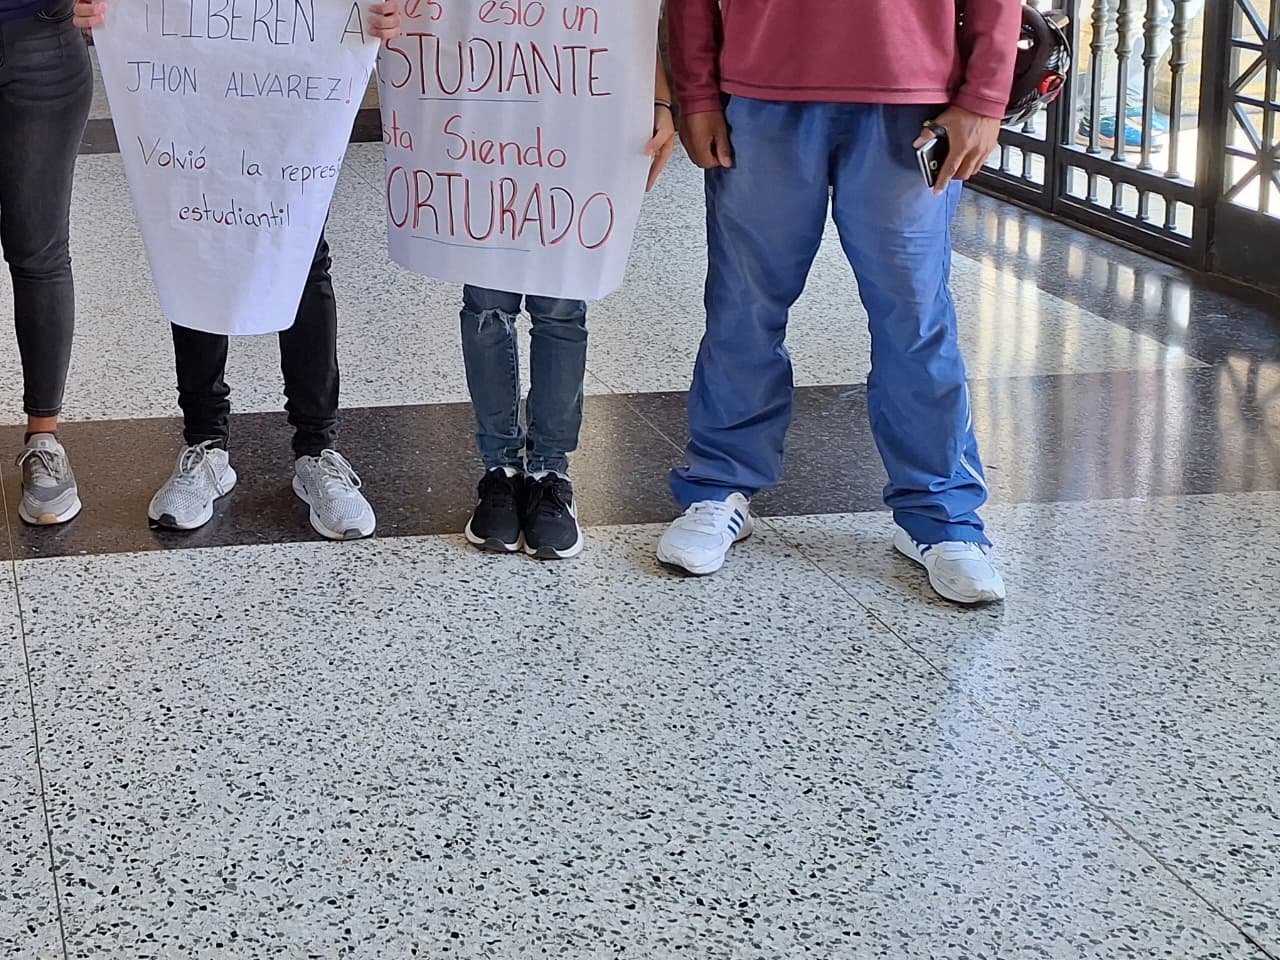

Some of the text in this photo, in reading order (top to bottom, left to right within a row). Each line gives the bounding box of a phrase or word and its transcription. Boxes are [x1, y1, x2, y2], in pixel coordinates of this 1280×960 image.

[340, 1, 365, 45] A
[562, 5, 599, 35] un
[126, 59, 198, 94] JHON
[137, 134, 207, 171] Volvió
[240, 149, 262, 178] la
[441, 114, 567, 169] Siendo
[178, 192, 292, 228] estudiantil
[385, 165, 615, 251] ORTURADO
